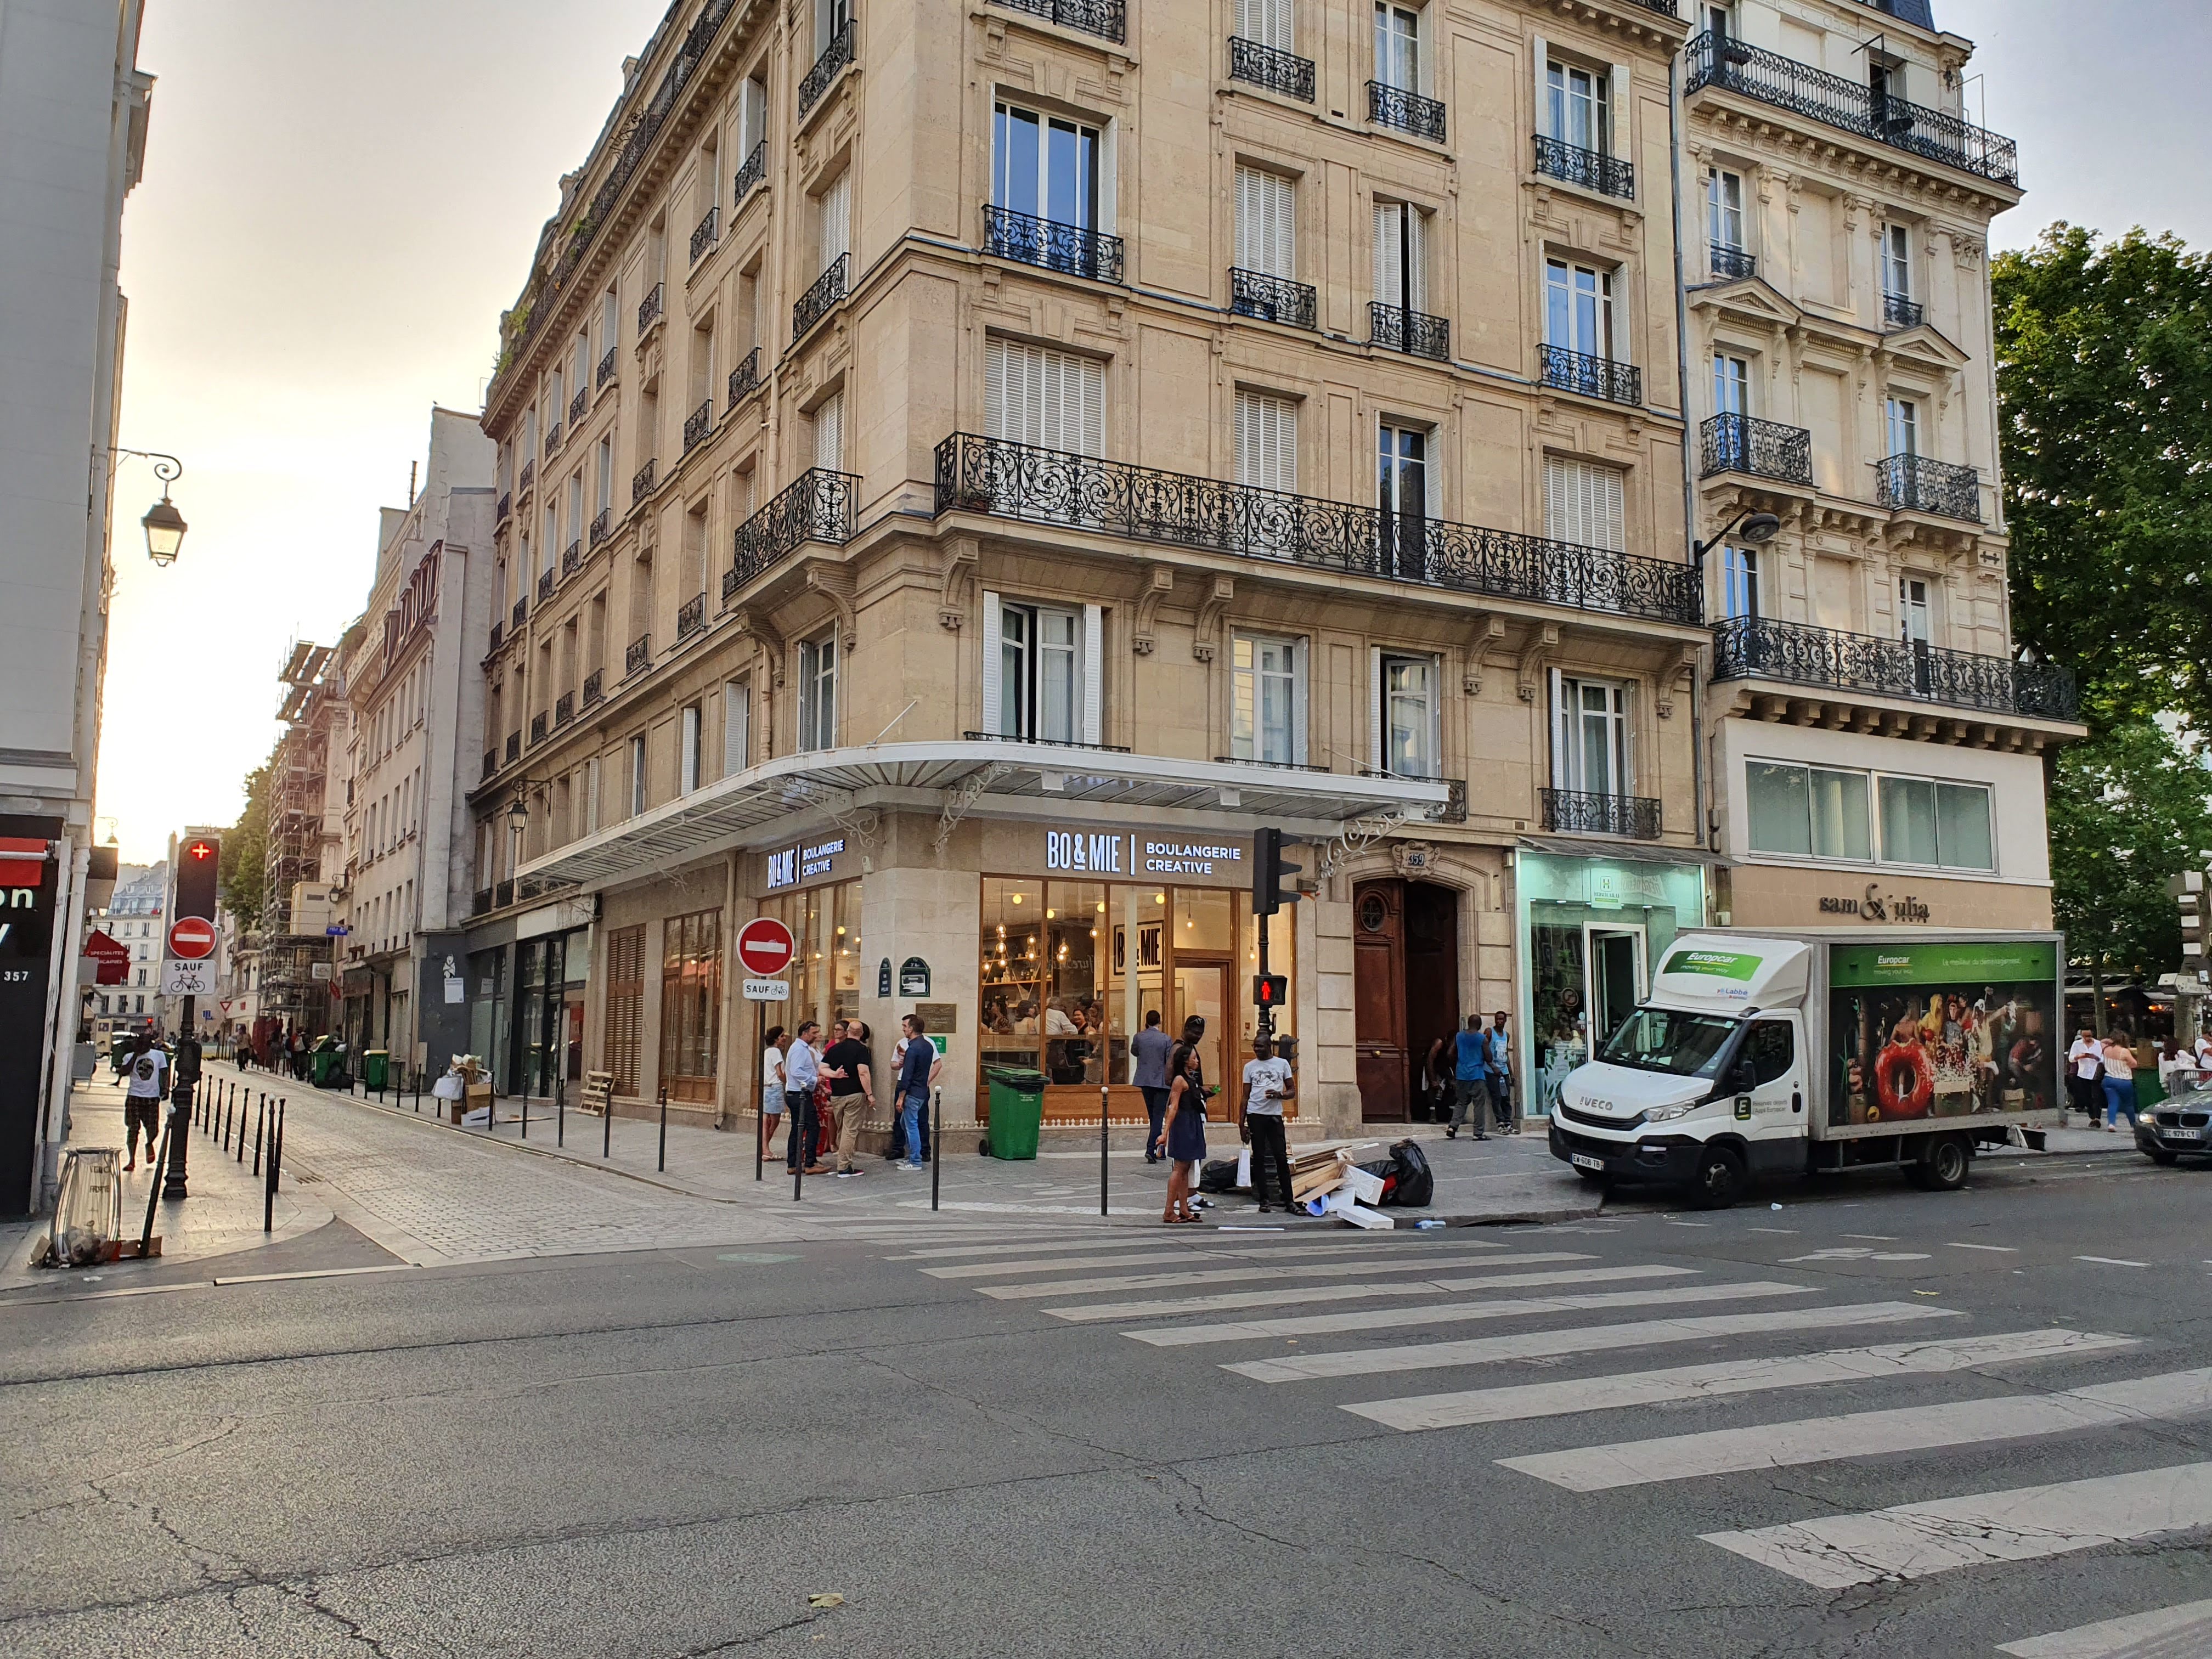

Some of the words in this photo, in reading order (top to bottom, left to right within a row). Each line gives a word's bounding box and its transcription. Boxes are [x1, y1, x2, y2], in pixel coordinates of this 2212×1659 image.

[803, 839, 844, 860] BOULANGERIE
[1146, 842, 1241, 860] BOULANGERIE
[1408, 853, 1424, 865] 359
[803, 859, 831, 876] CREATIVE
[1146, 859, 1212, 874] CREATIVE
[1820, 896, 1858, 914] sam
[1860, 883, 1887, 920] &
[1686, 952, 1738, 963] Europcar
[1878, 955, 1910, 965] Europcar
[174, 963, 204, 971] SAUF
[4, 971, 29, 981] 357
[746, 985, 770, 994] SAUF
[1579, 1096, 1613, 1111] IVECO
[1739, 1099, 1748, 1113] E
